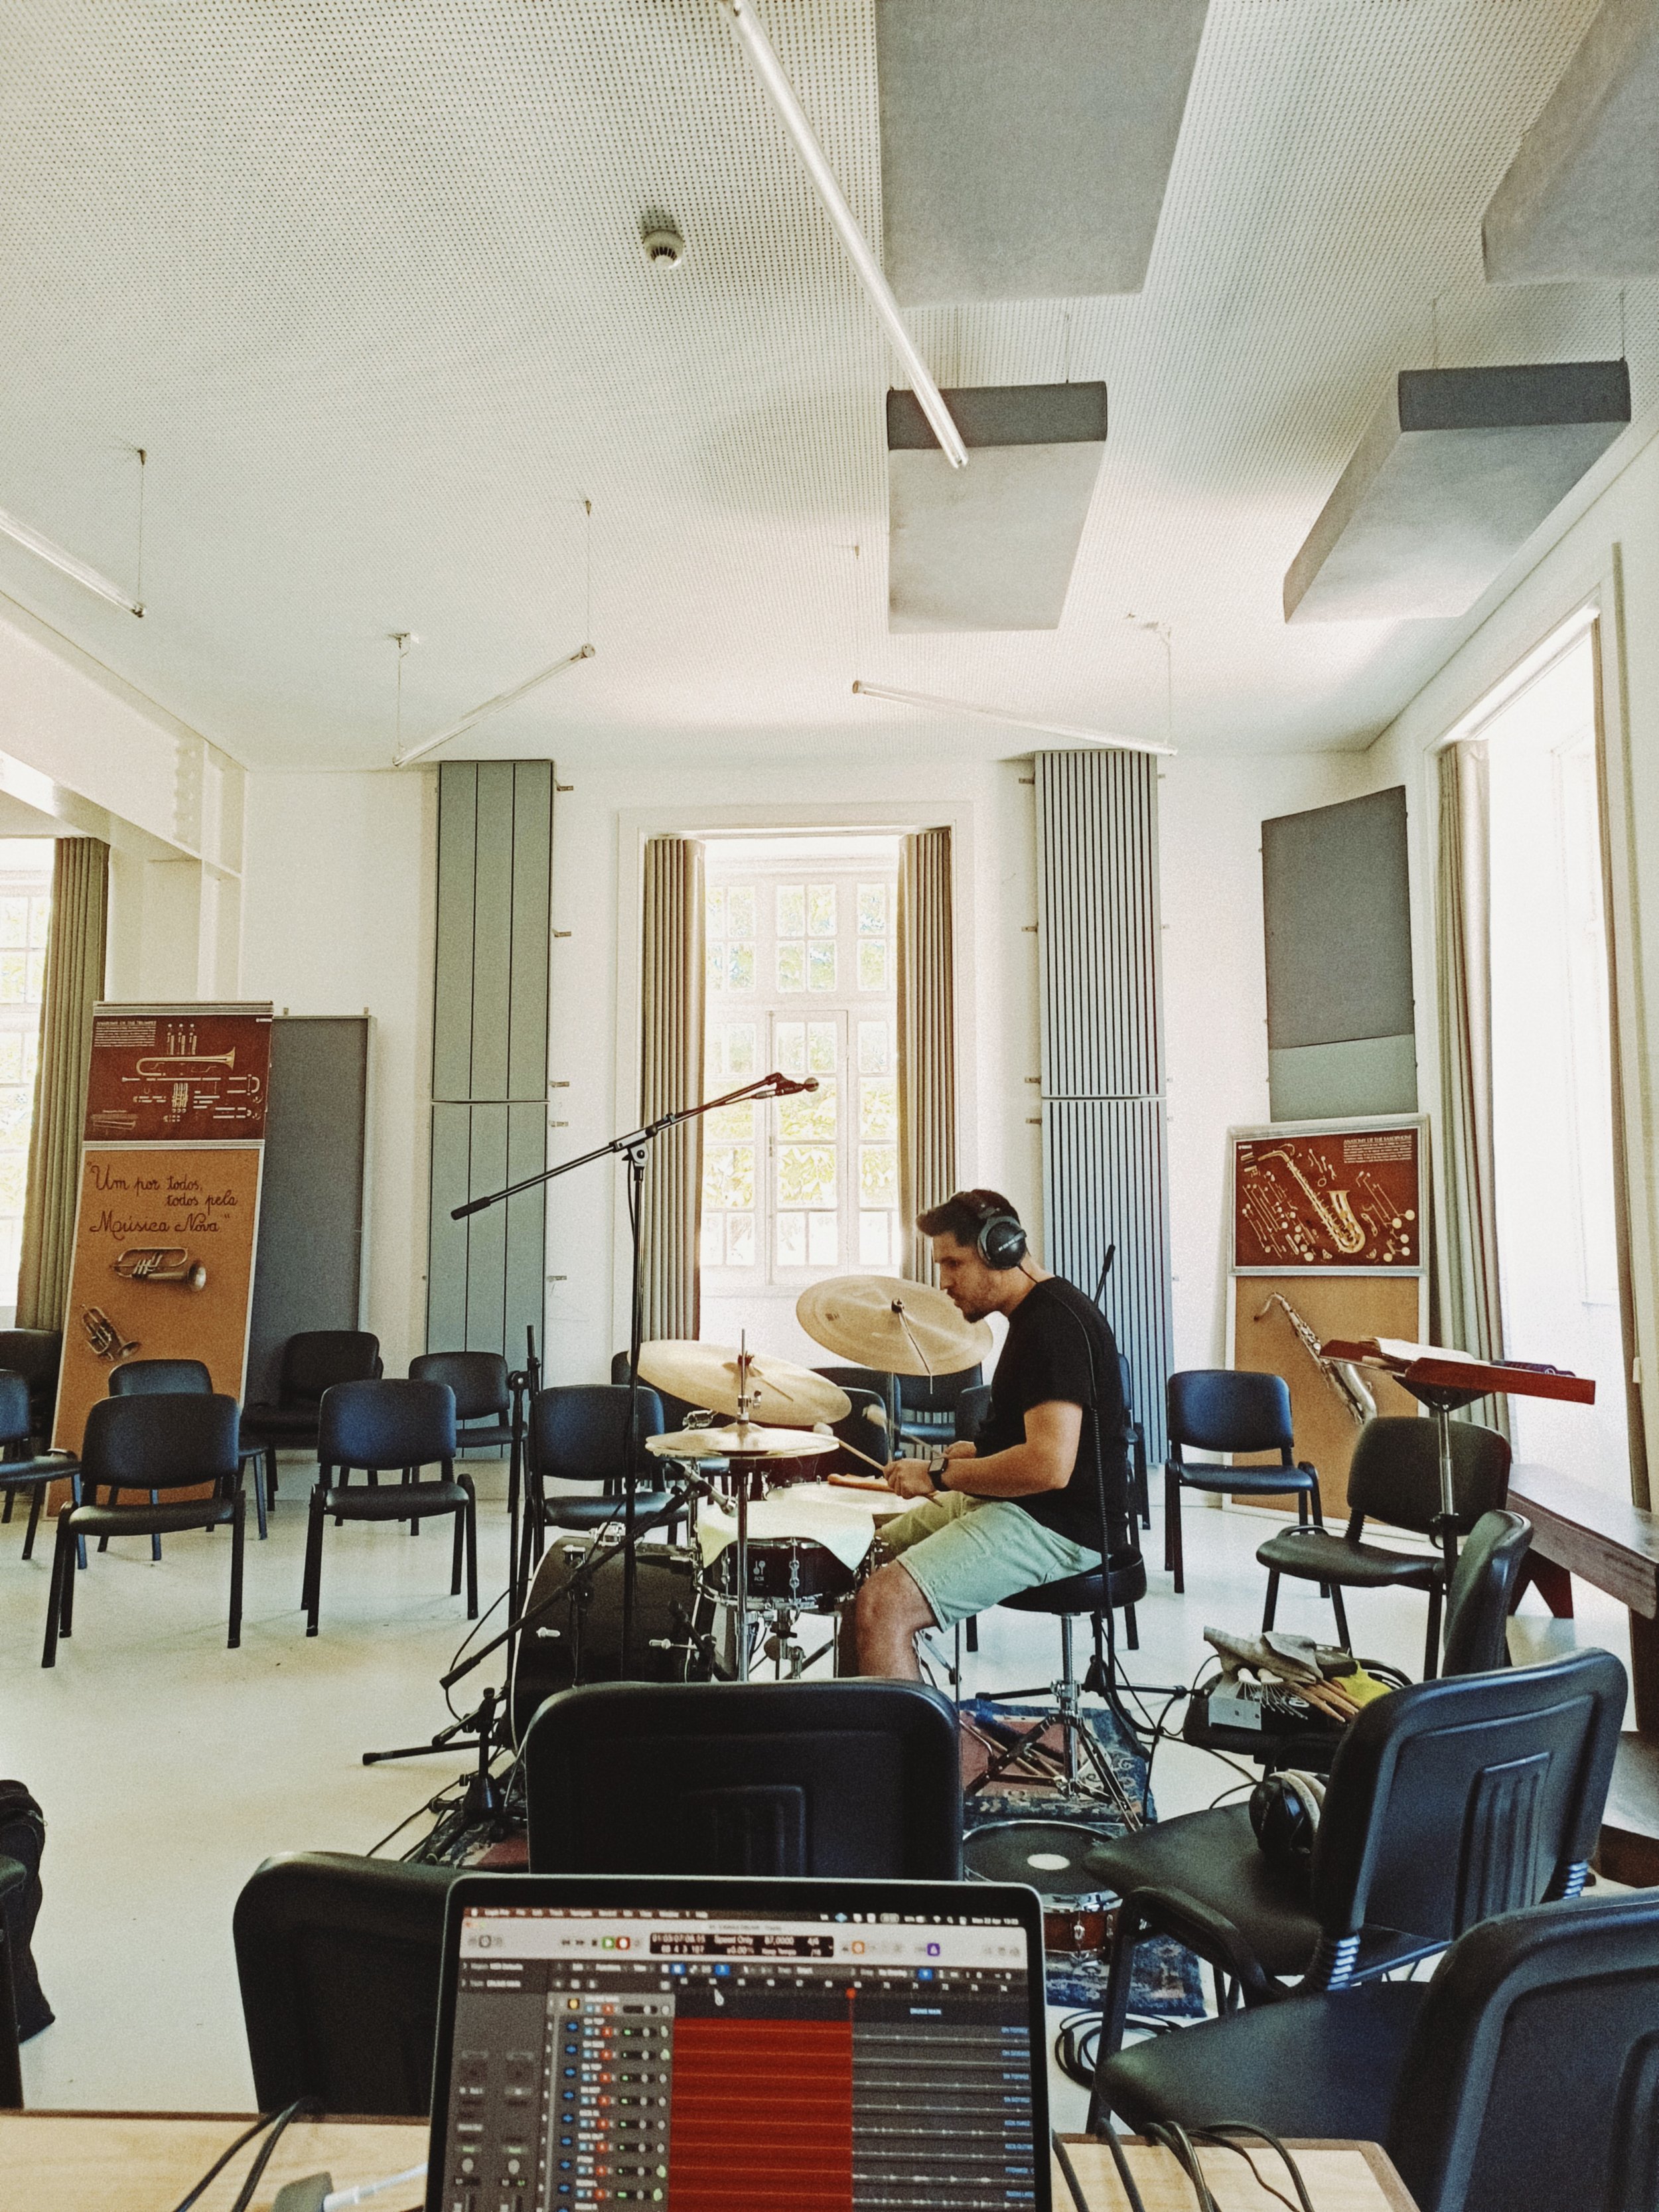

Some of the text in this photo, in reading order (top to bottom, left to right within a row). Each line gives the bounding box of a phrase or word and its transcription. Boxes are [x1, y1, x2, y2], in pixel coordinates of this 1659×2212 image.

[133, 1177, 161, 1197] por
[166, 1173, 202, 1191] todos,
[165, 1189, 238, 1216] todos pela
[89, 1210, 171, 1241] Música
